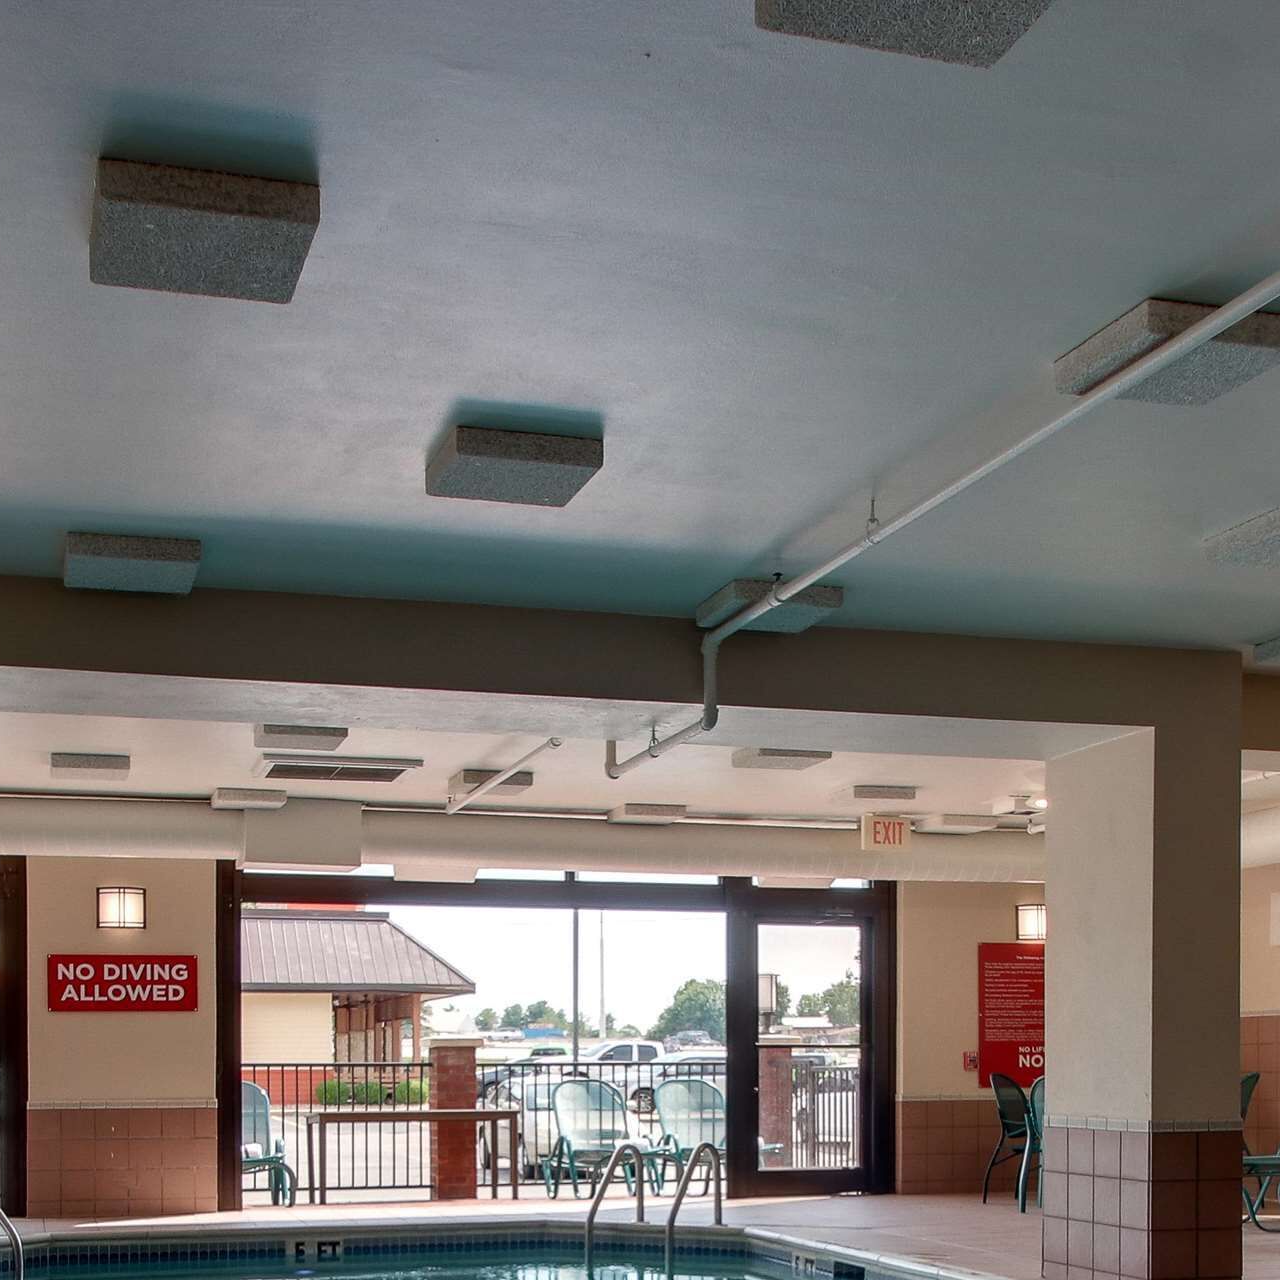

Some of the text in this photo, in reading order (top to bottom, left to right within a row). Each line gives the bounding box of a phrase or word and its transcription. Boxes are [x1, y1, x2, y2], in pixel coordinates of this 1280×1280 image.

[873, 821, 904, 845] EXIT
[57, 963, 189, 981] NO DIVING
[60, 984, 185, 1001] ALLOWED
[1018, 1054, 1044, 1068] NO
[317, 1241, 340, 1257] FT
